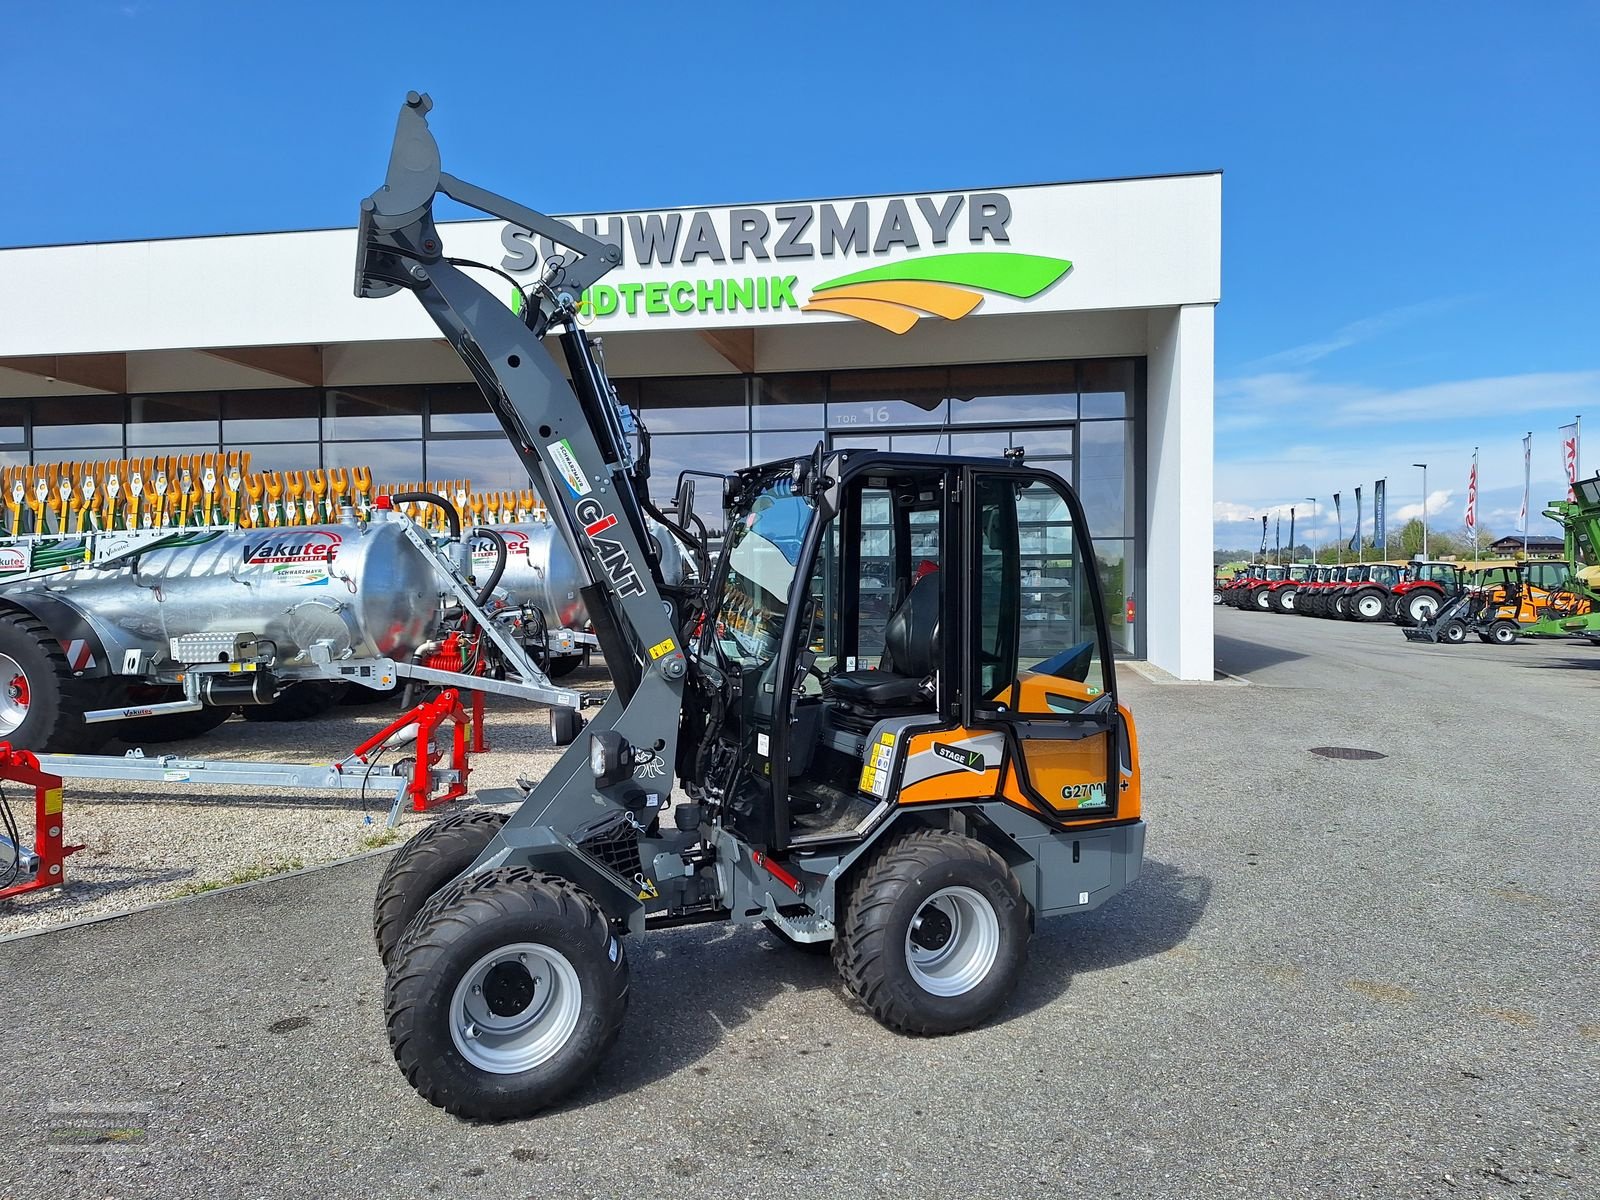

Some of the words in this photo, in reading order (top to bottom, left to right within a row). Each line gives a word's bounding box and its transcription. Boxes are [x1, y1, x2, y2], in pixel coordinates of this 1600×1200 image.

[511, 275, 799, 317] DTECHNIK
[836, 415, 857, 424] TOR
[864, 406, 890, 423] 16
[560, 445, 584, 487] SCHWARZMAYR
[243, 540, 341, 564] Vakutec
[277, 568, 322, 576] SCHWARZMAYR
[940, 748, 966, 764] STAGE
